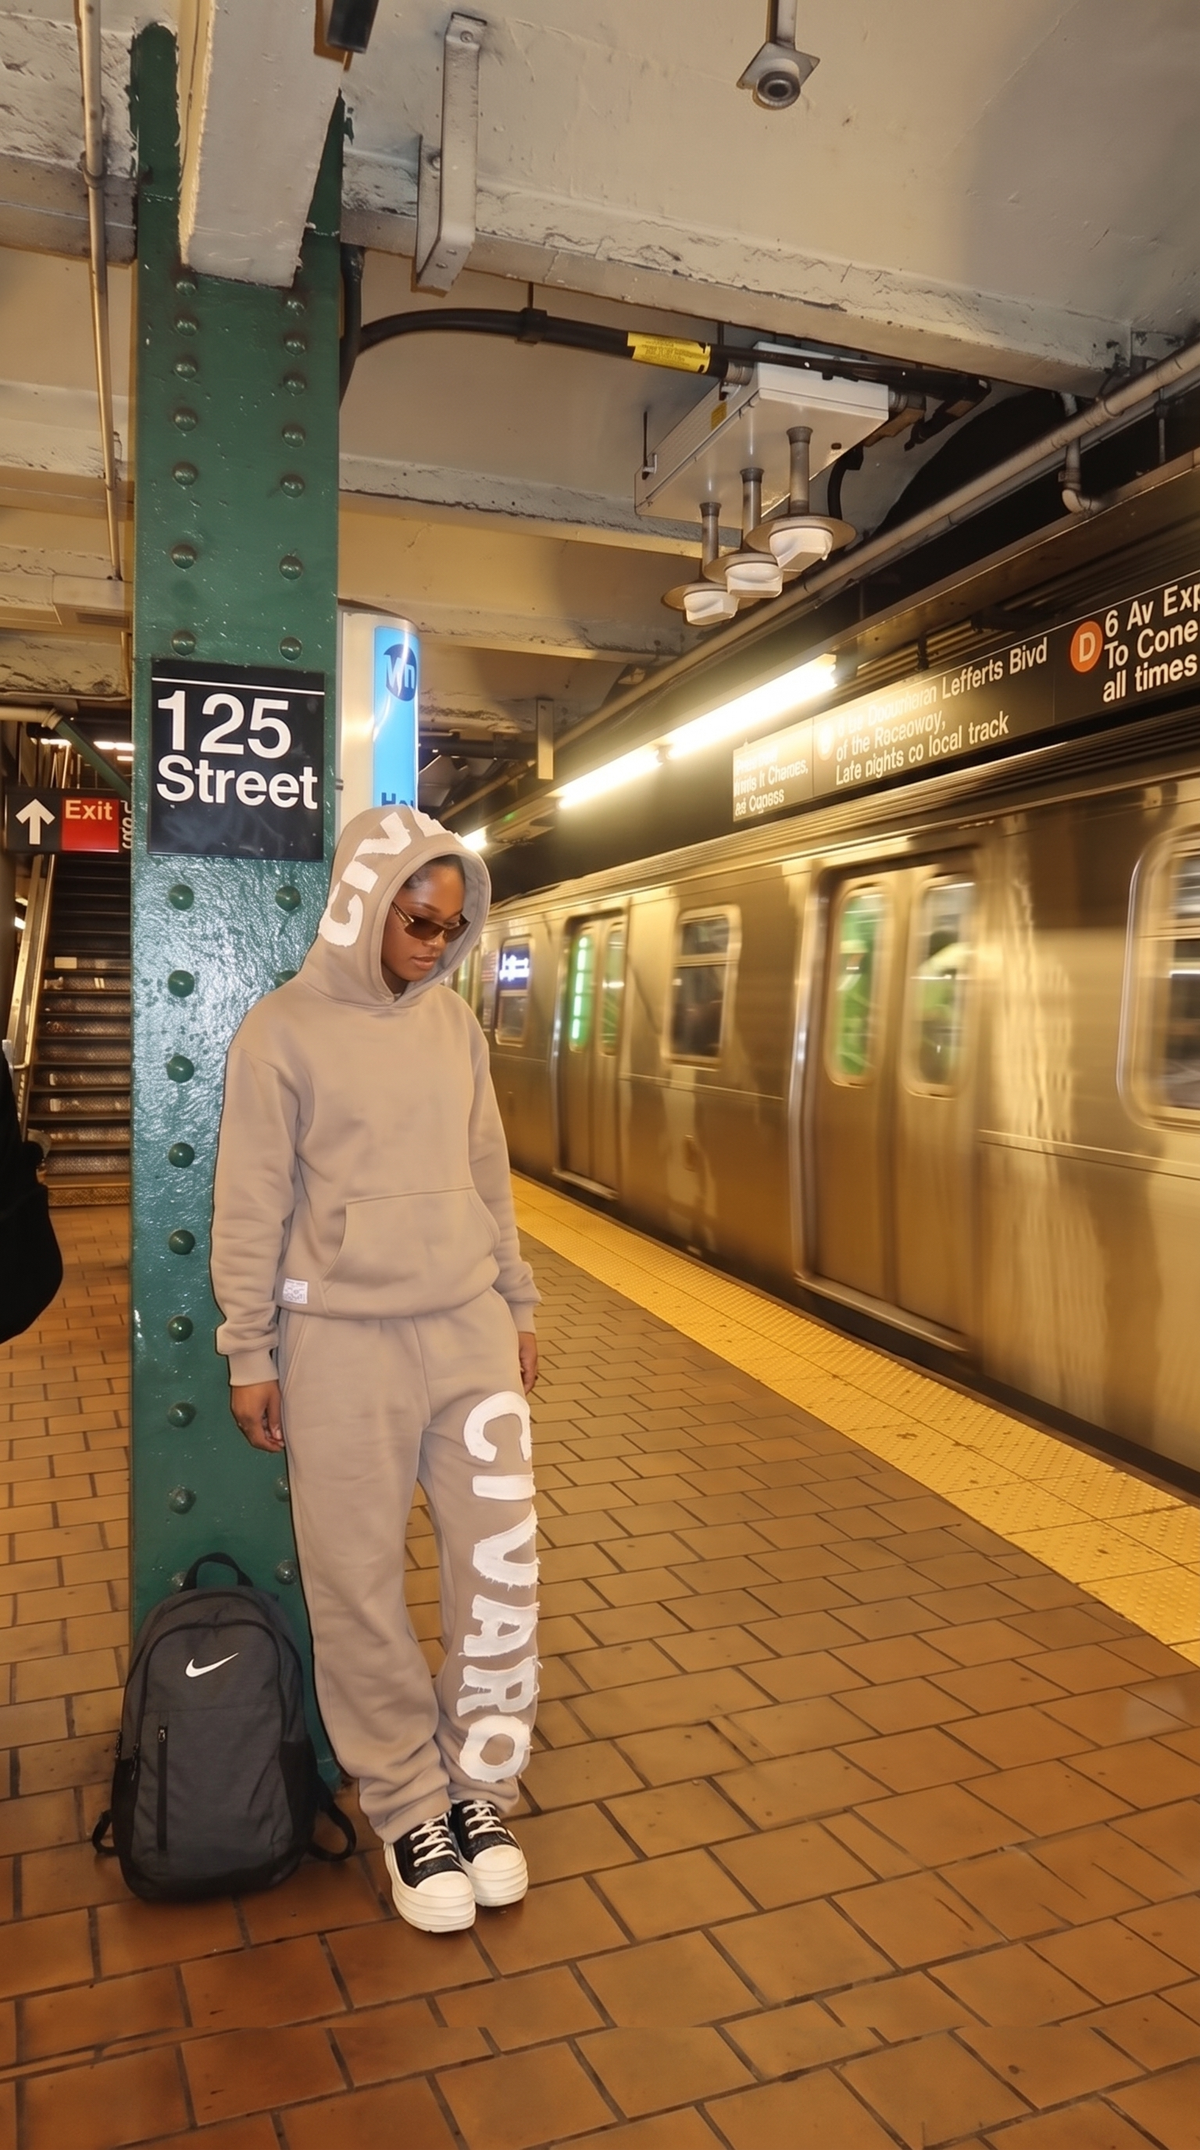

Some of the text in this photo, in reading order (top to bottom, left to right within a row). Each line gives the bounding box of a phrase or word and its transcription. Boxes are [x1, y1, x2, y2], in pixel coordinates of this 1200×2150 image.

[1105, 609, 1118, 638] 6
[1127, 600, 1154, 631] Av
[1079, 631, 1096, 663] D
[1104, 619, 1199, 670] To Cone
[942, 659, 1004, 700] Lefferts
[1103, 653, 1198, 703] all times
[157, 690, 292, 759] 125
[836, 738, 848, 762] of
[852, 732, 870, 756] the
[929, 725, 963, 758] local
[969, 710, 1010, 745] track
[156, 754, 318, 810] Street
[65, 799, 113, 820] Exit
[457, 1391, 541, 1783] CIVARO
